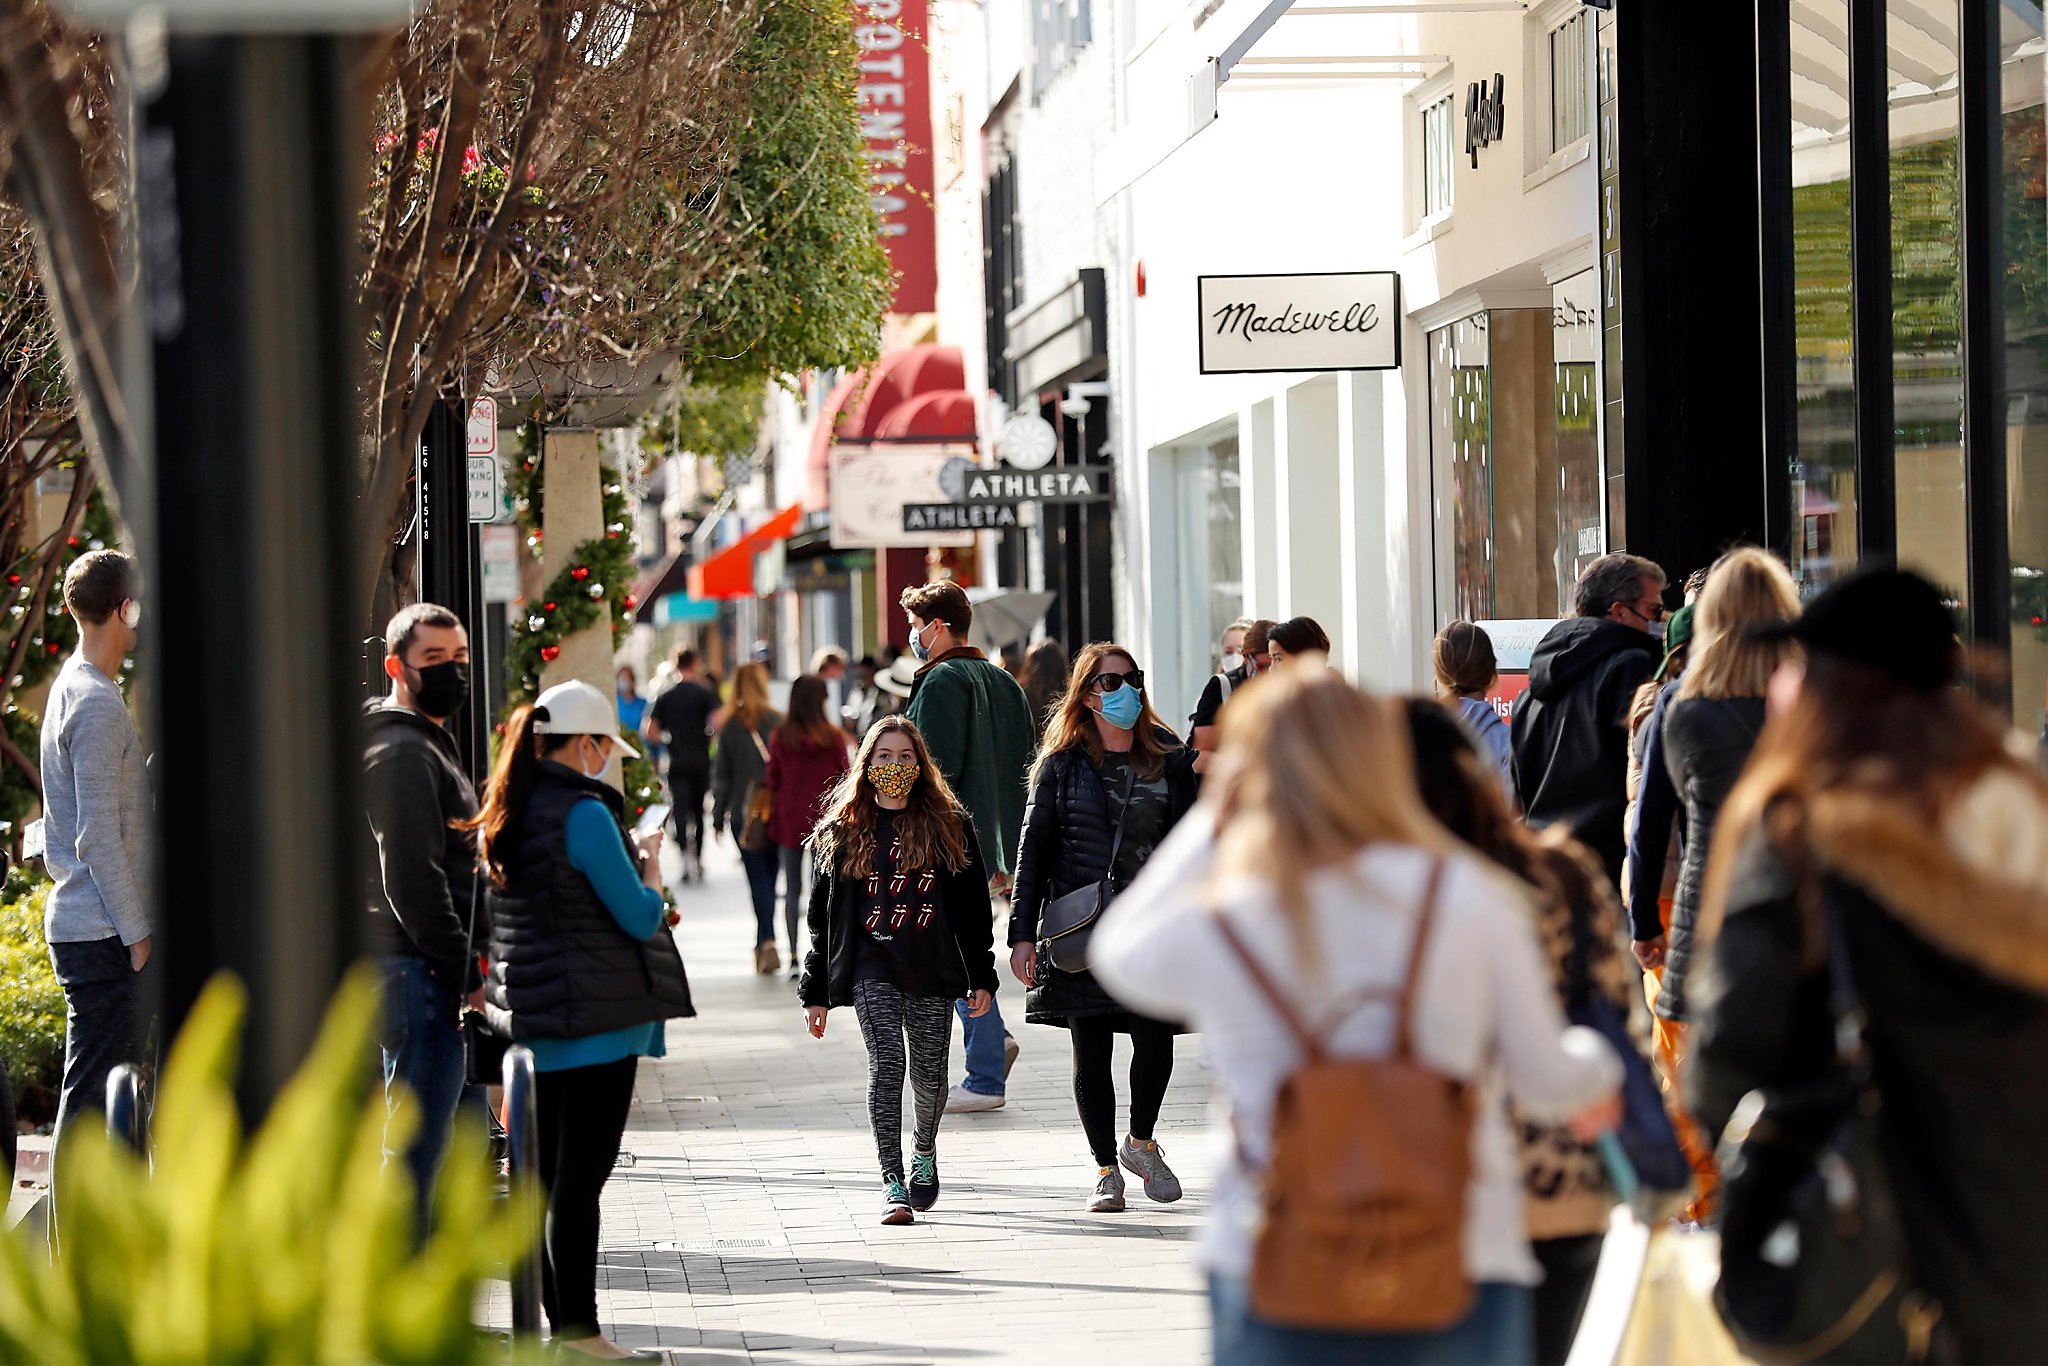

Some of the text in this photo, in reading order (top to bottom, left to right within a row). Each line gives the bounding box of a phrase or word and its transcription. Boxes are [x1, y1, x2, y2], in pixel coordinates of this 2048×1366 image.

[1213, 302, 1379, 342] Madewell
[470, 471, 492, 481] KING
[968, 473, 1092, 499] ATHLETA
[906, 504, 1016, 529] ATHLETA
[1484, 696, 1513, 717] list
